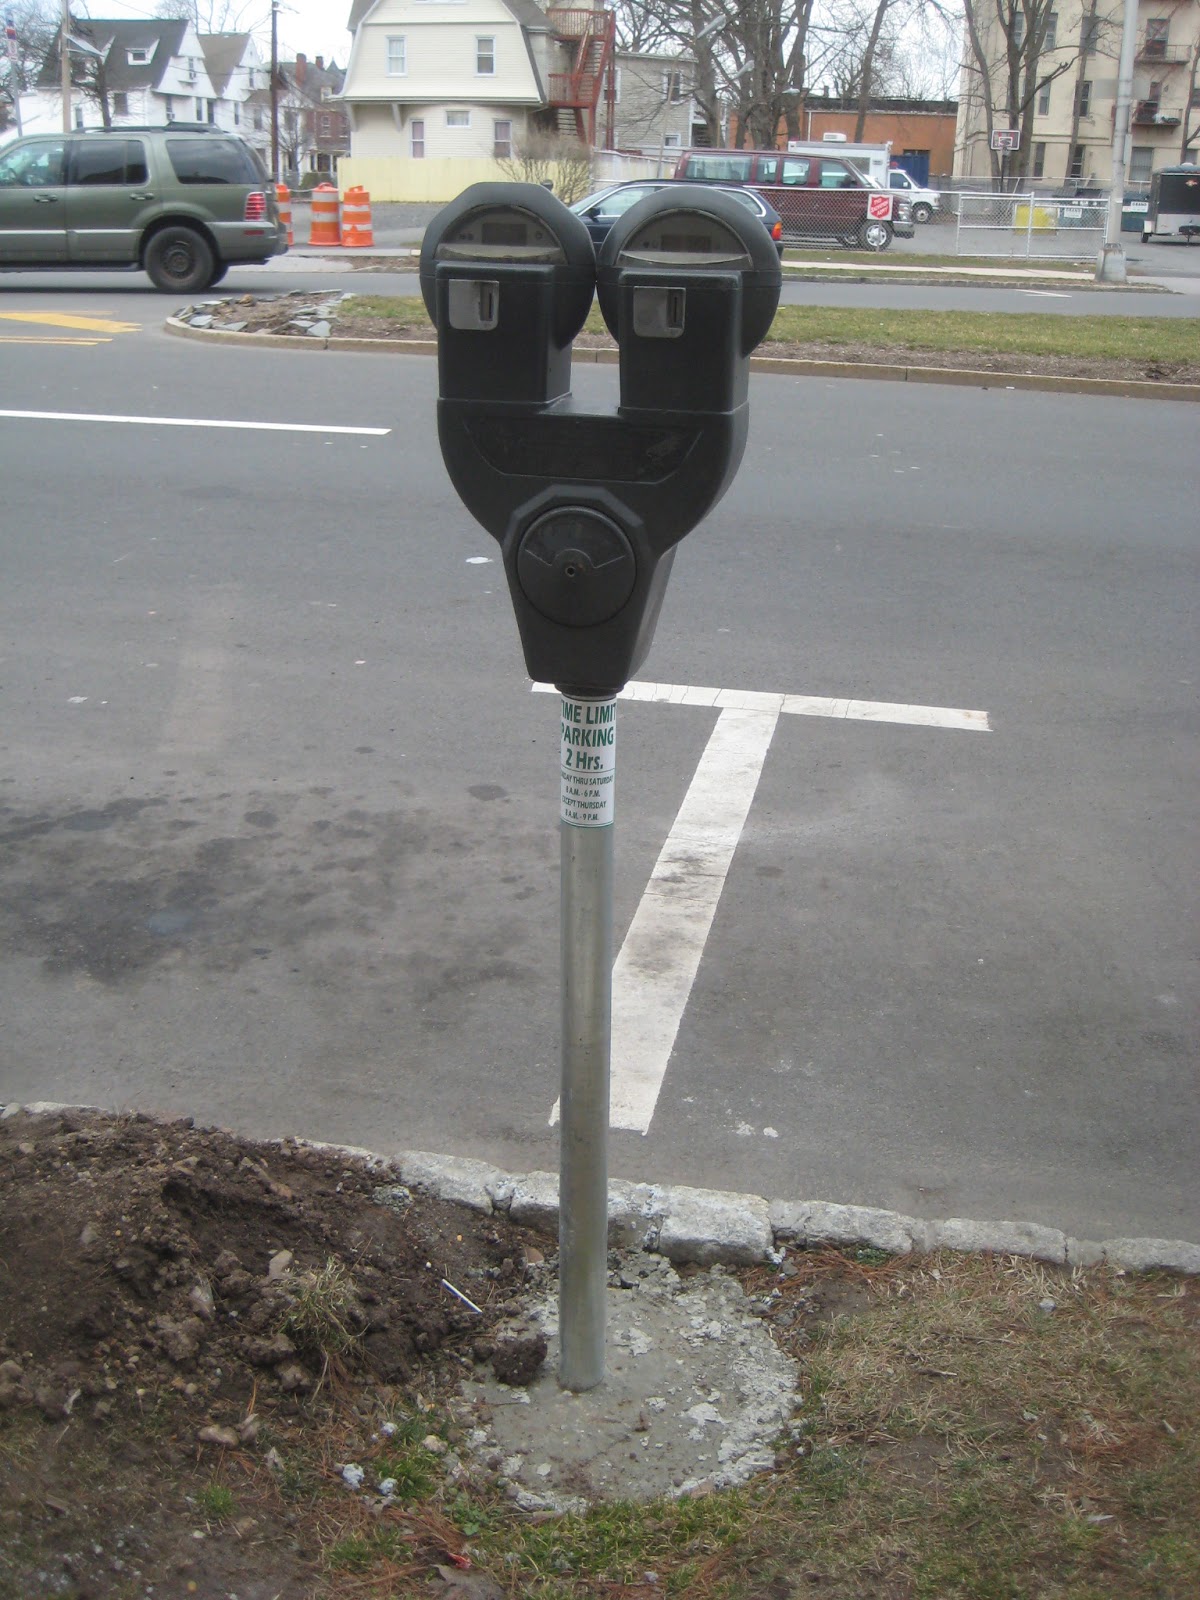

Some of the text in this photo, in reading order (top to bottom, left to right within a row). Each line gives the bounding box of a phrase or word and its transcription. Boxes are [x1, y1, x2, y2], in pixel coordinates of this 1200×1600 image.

[565, 747, 604, 770] 2 Hrs.
[573, 776, 588, 785] THRU
[577, 800, 607, 809] THURSDAY
